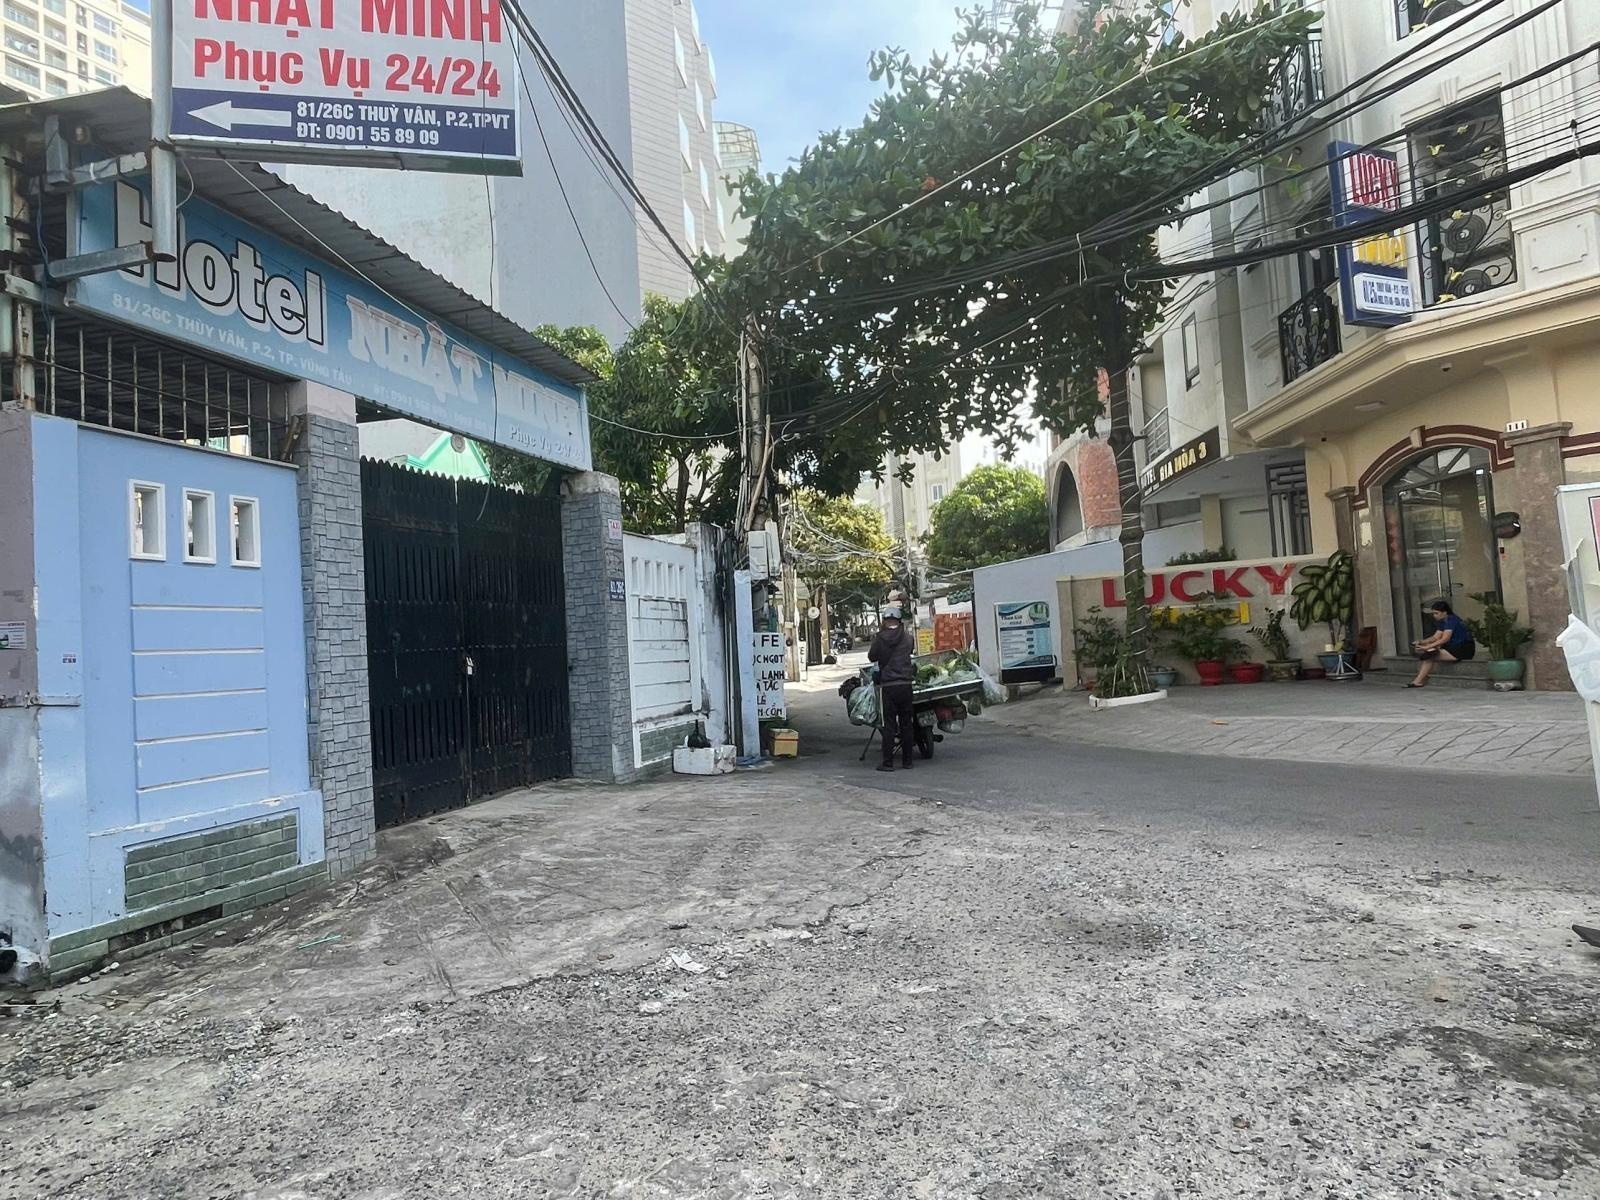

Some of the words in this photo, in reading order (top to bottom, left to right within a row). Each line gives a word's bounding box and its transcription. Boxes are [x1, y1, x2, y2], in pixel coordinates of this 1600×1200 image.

[194, 39, 303, 91] Phục
[318, 47, 371, 97] Vụ
[385, 53, 501, 98] 24/24
[296, 121, 321, 139] ĐT:
[325, 123, 364, 141] 0901
[370, 126, 390, 143] 55
[394, 127, 415, 144] 89
[419, 129, 439, 146] 09
[297, 101, 354, 120] 81/26C
[404, 105, 441, 128] VÂN,
[1349, 152, 1399, 212] LUCKY
[114, 178, 326, 346] Hotel
[1159, 460, 1174, 482] GIA
[1198, 441, 1207, 459] 3
[1102, 563, 1296, 608] LUCKY
[761, 634, 780, 648] FE
